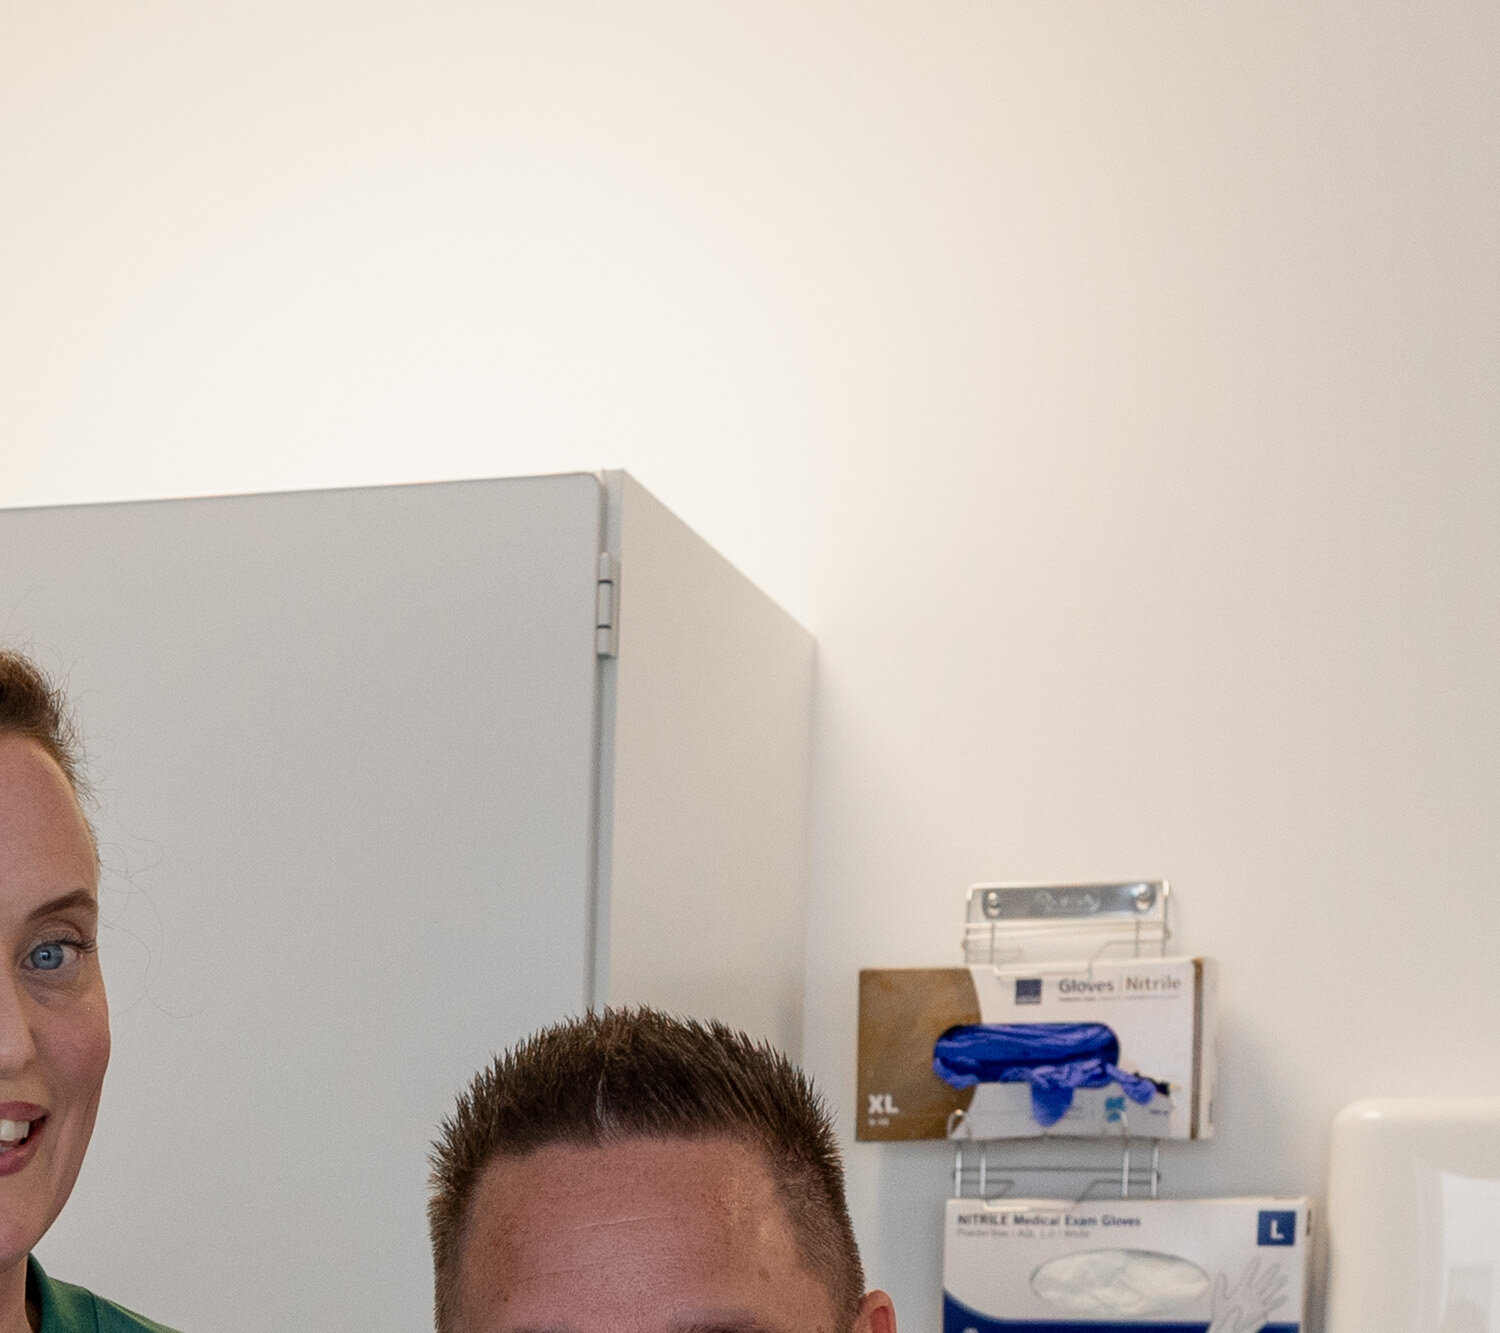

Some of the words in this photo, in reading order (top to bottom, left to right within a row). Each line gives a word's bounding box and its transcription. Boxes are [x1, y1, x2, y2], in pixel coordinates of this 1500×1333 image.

[1059, 978, 1114, 994] Gloves
[1125, 975, 1181, 991] Nitrile
[868, 1094, 898, 1114] XL
[957, 1214, 1007, 1226] NITRILE
[1013, 1214, 1061, 1226] Medical
[1065, 1215, 1098, 1227] Exam
[1101, 1215, 1141, 1227] Gloves
[1270, 1221, 1284, 1240] L
